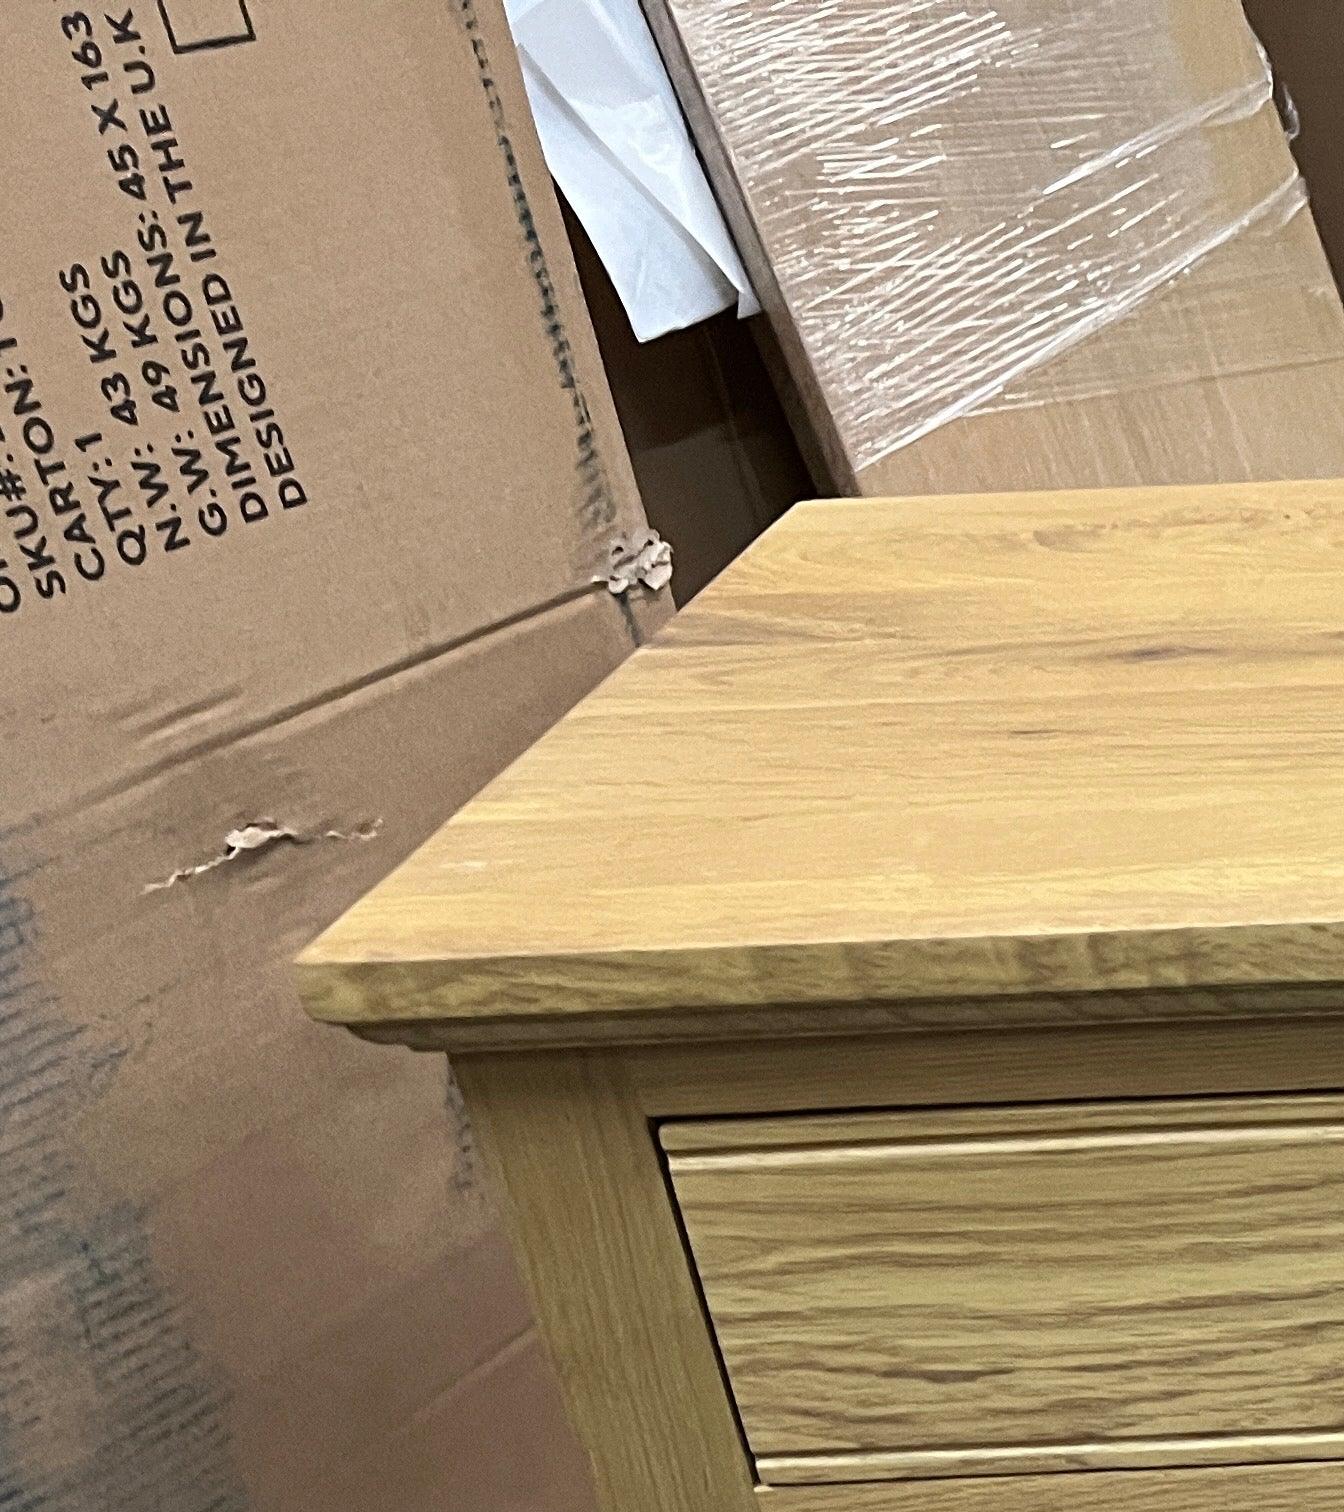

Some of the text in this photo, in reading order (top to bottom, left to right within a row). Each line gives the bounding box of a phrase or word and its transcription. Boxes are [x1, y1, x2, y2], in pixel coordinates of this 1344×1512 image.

[61, 11, 269, 524] DIMENSIONS: 45 X 163
[100, 250, 228, 537] G.W: 49 KGS
[104, 8, 308, 510] DESIGNED IN THE U.K
[5, 364, 106, 581] CARTON:
[58, 263, 191, 553] N.W: 43 KGS
[74, 432, 147, 566] QTY: 1
